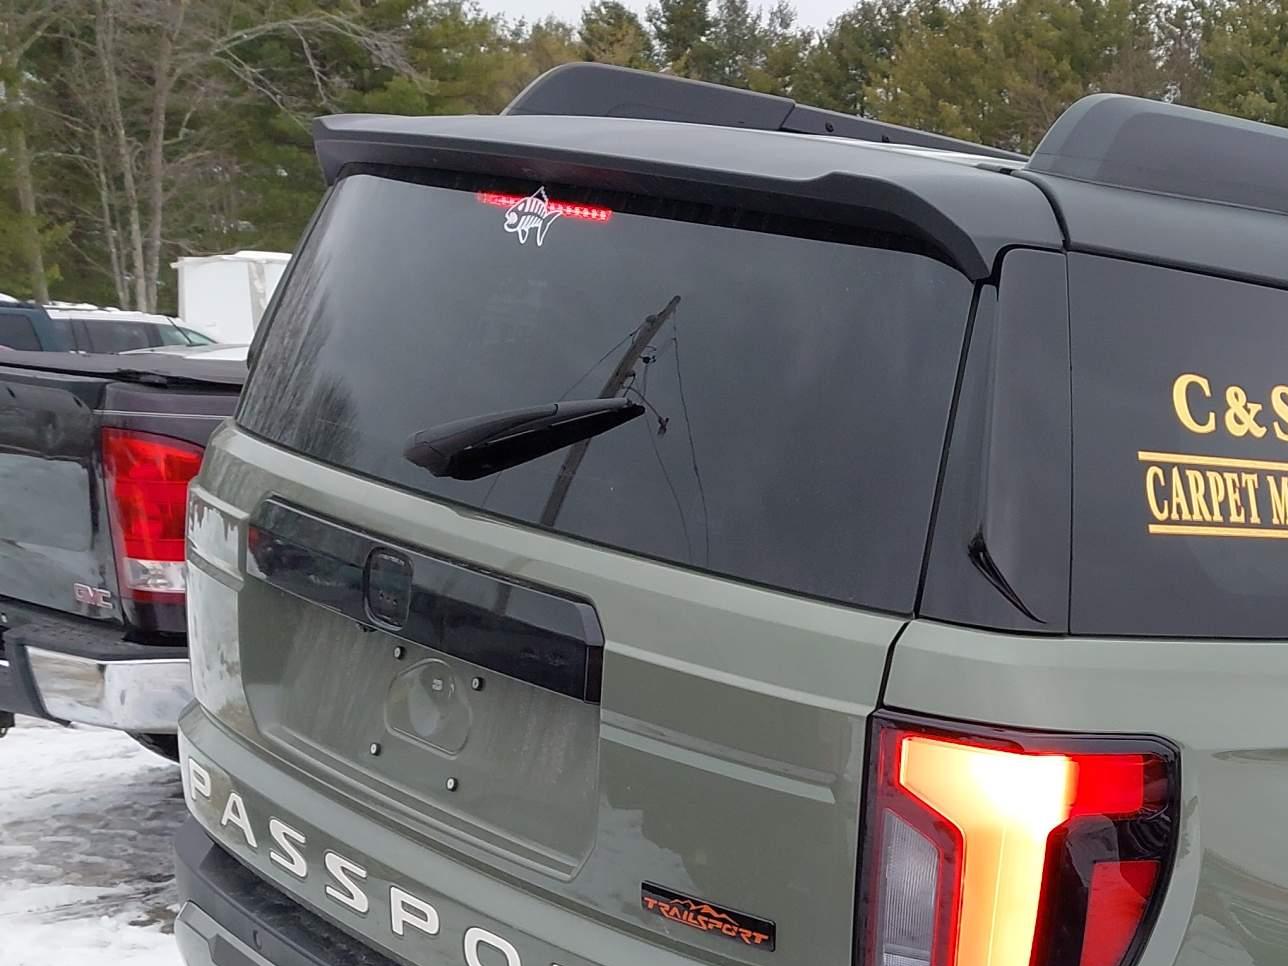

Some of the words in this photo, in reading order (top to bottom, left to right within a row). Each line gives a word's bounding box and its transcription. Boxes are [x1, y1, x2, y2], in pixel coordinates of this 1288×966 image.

[1145, 465, 1262, 525] CARPET
[73, 583, 113, 609] GMC
[643, 896, 769, 945] TRAILSPORT
